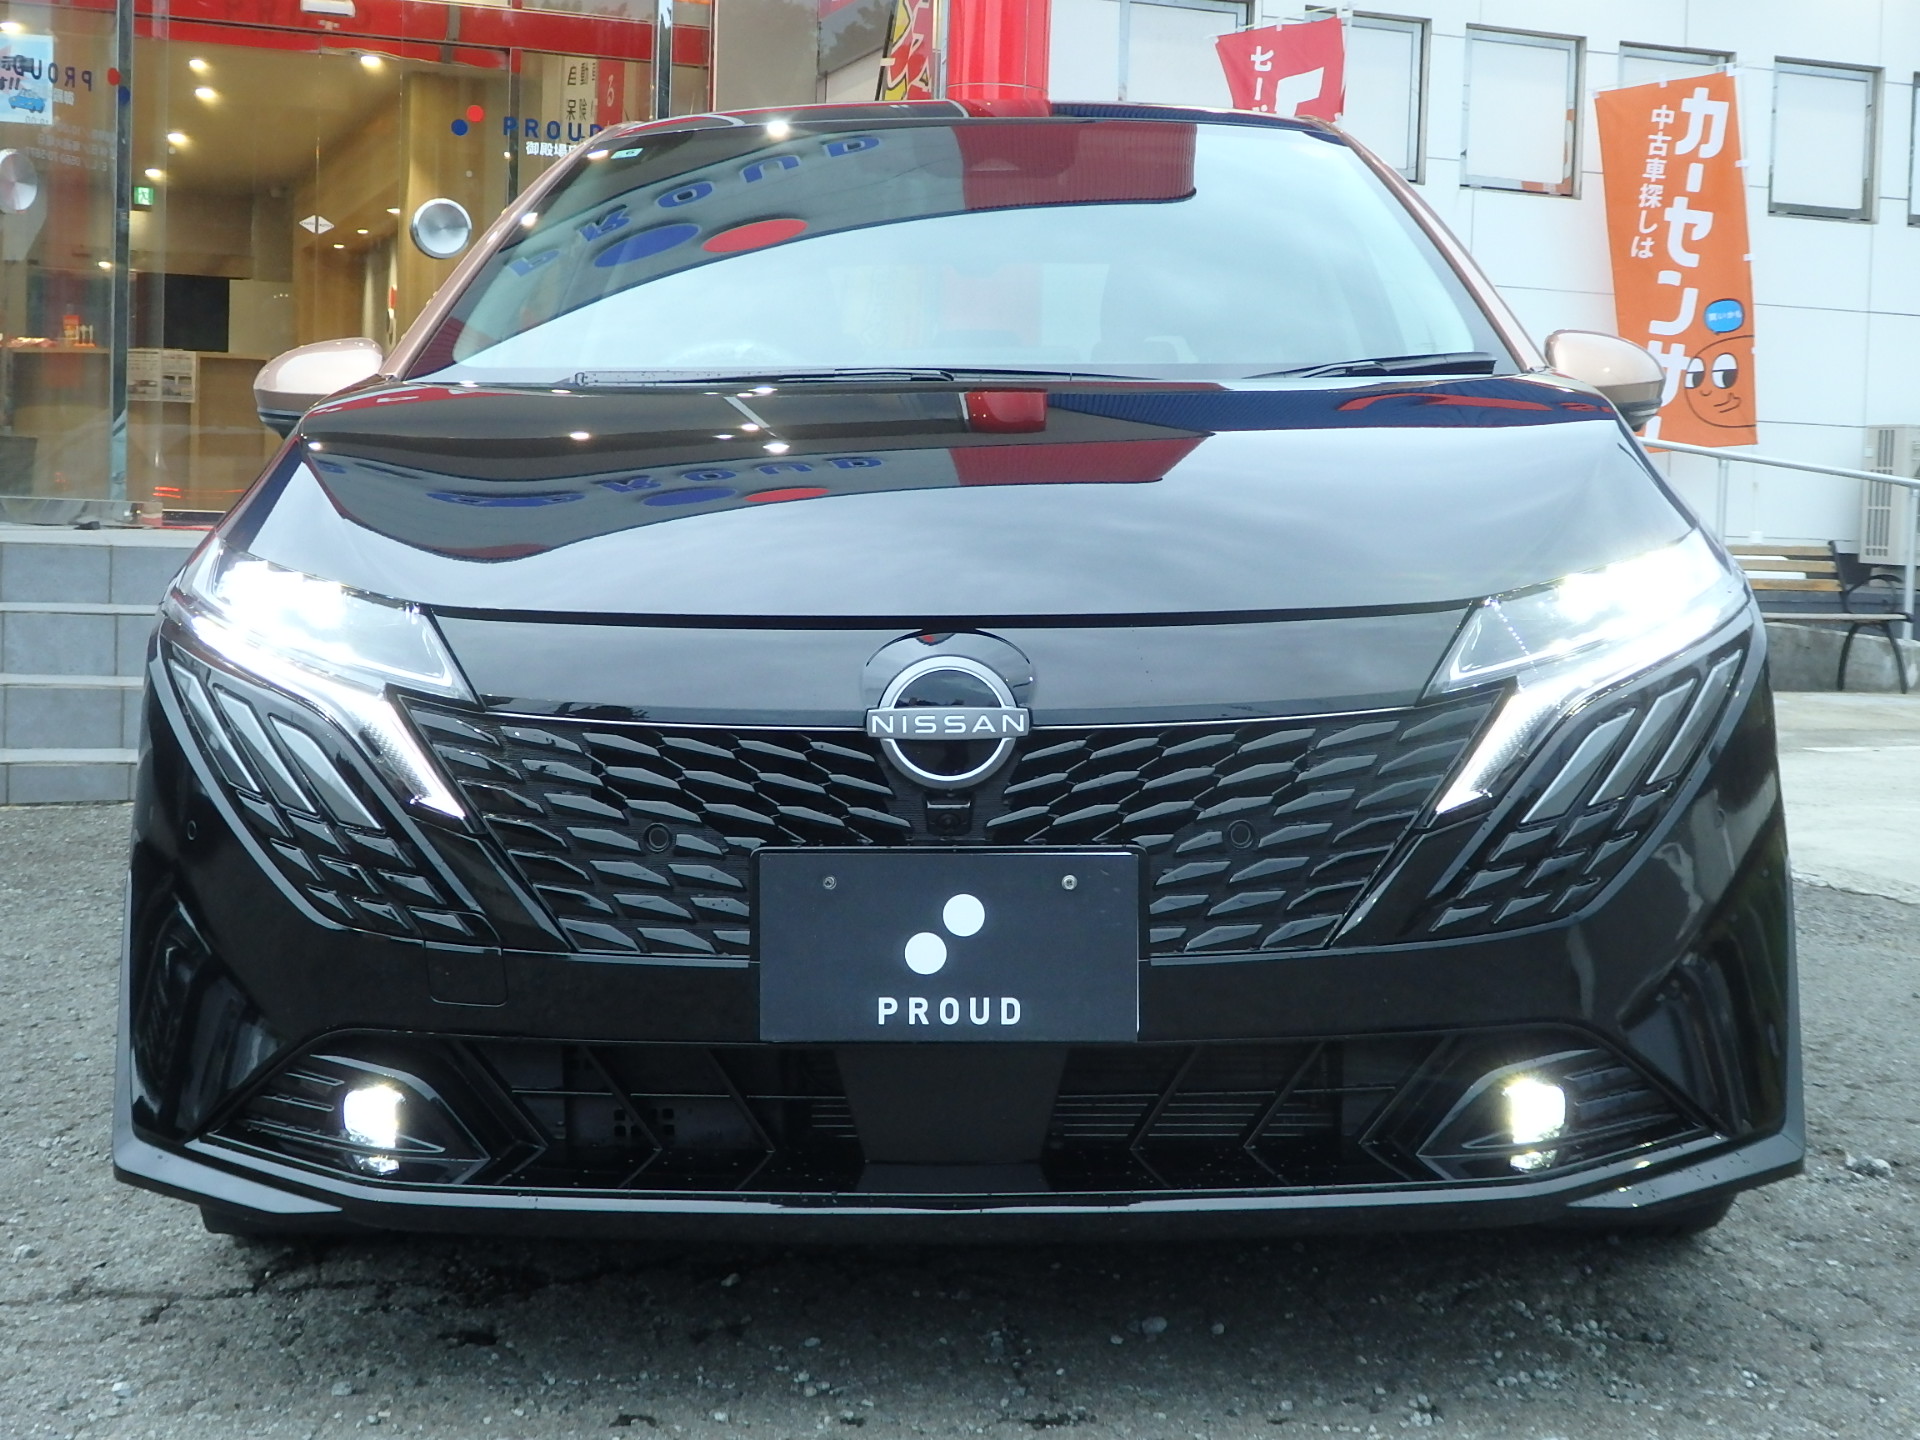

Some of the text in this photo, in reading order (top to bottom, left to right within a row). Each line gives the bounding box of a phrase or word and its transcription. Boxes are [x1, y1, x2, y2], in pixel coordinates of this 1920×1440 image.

[1631, 104, 1676, 259] 中古車探しは
[871, 714, 1025, 734] NISSAN
[878, 996, 1021, 1026] PROUD
